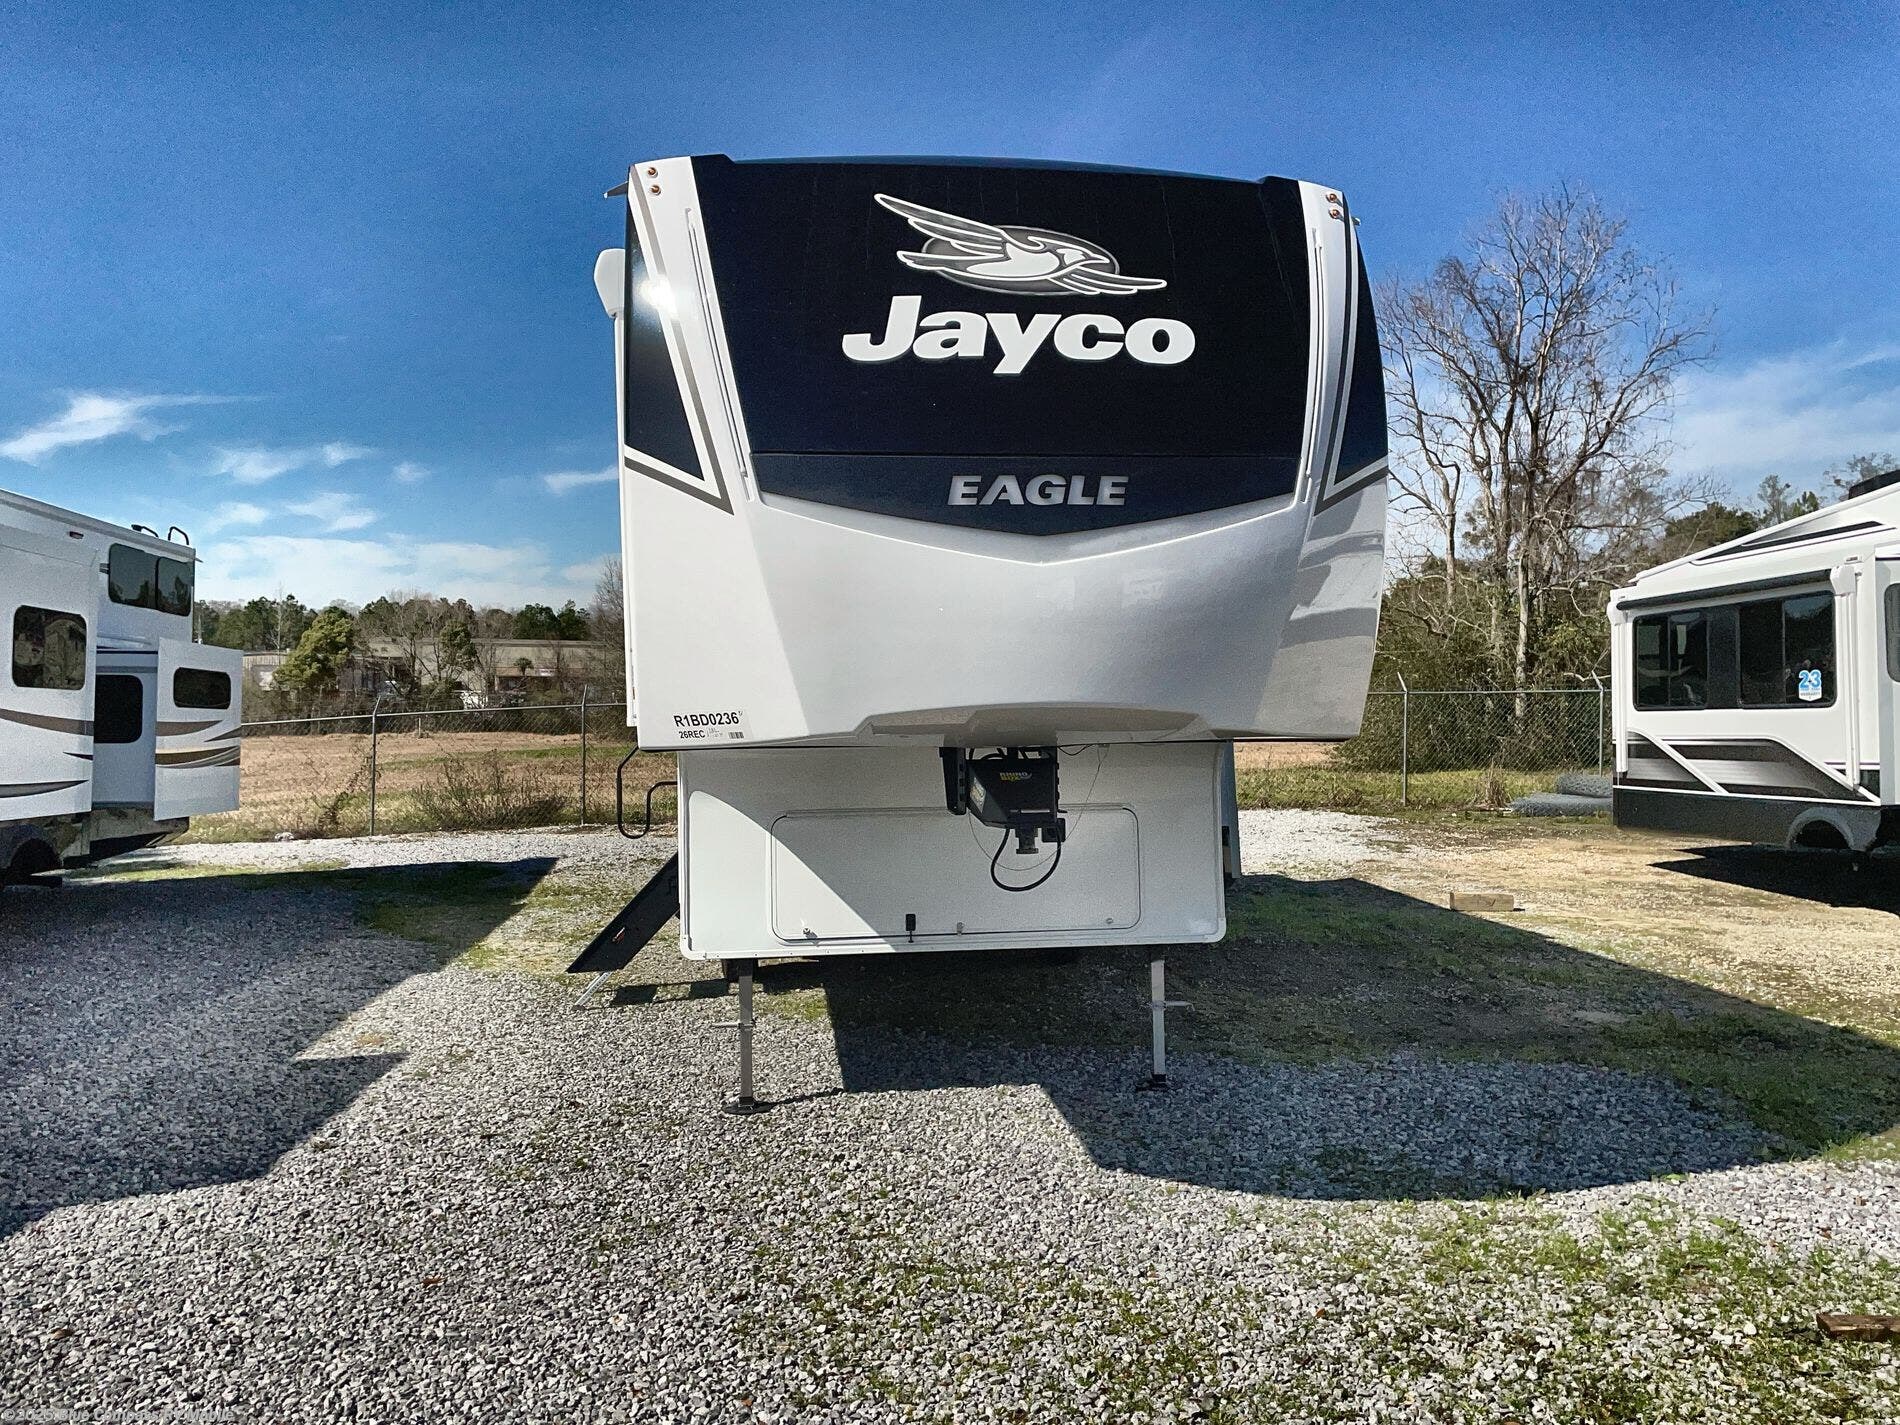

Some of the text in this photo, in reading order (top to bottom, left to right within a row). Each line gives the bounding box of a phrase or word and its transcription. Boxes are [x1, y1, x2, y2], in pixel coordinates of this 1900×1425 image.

[842, 295, 1196, 374] Jayco
[948, 475, 1129, 505] EAGLE
[673, 712, 740, 727] R1BD0236
[679, 730, 706, 739] 26REC
